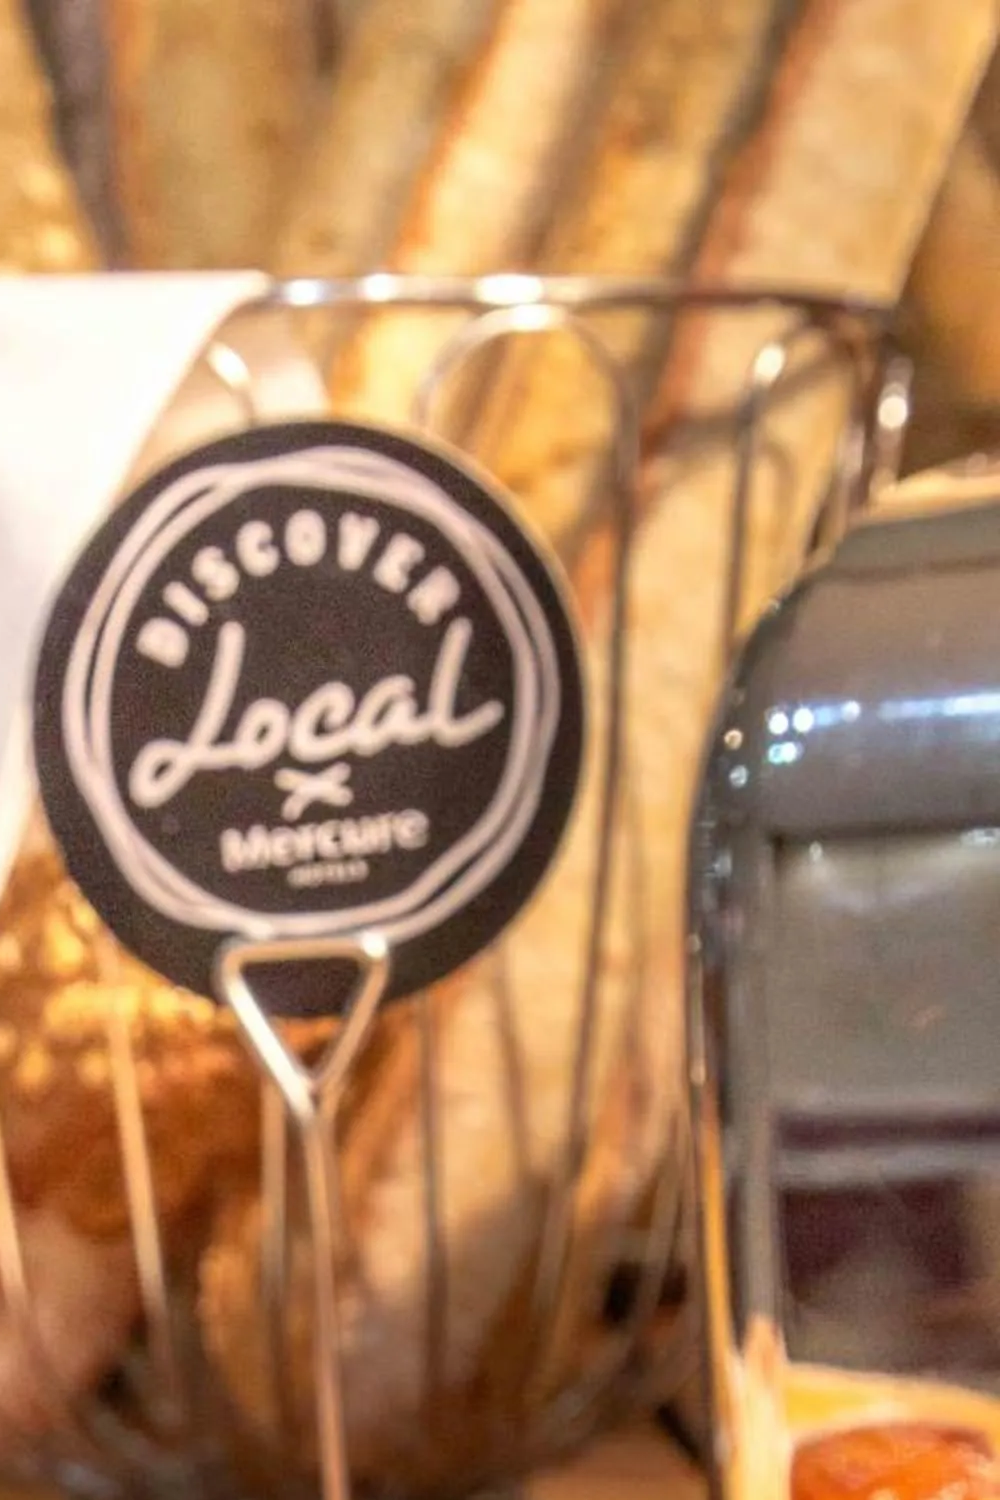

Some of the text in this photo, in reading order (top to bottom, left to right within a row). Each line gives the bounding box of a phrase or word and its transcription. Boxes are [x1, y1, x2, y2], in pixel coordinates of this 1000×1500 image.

[137, 510, 460, 668] DISCOVER
[129, 617, 503, 808] Local
[220, 808, 430, 872] Mercure
